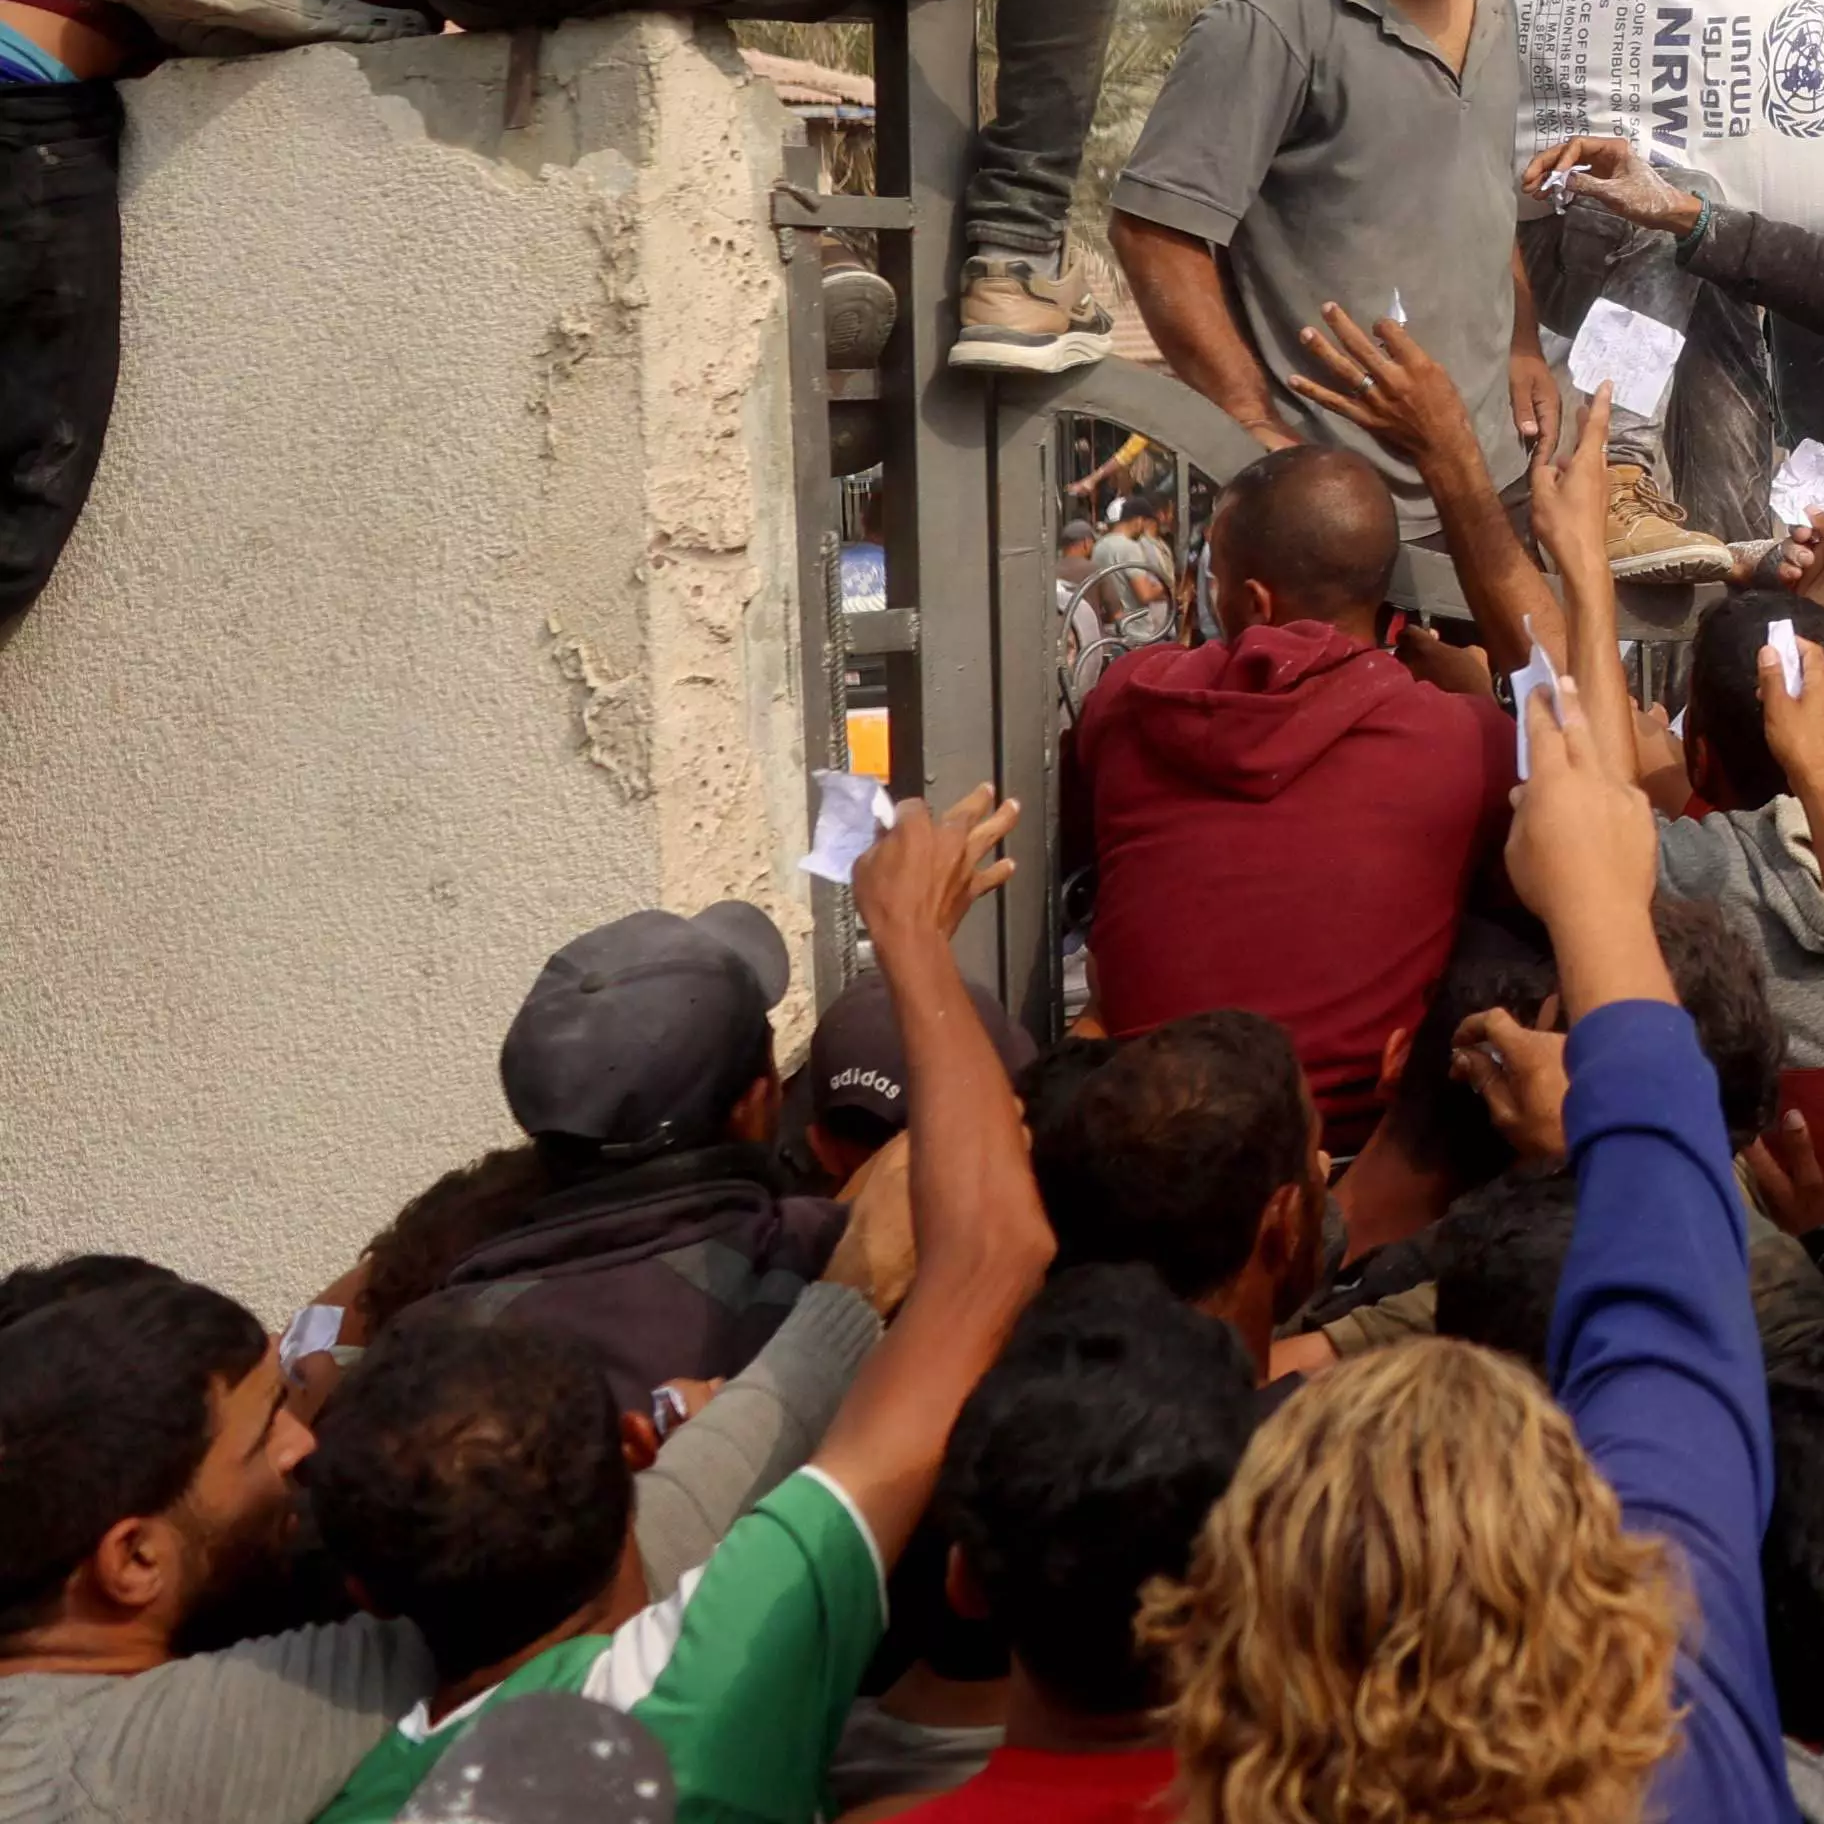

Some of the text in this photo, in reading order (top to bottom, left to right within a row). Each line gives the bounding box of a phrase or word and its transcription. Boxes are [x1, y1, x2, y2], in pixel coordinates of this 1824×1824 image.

[1533, 25, 1545, 51] SEP
[1545, 22, 1558, 53] MAR
[1560, 6, 1577, 60] MONTHS
[1576, 27, 1590, 49] OF
[1610, 6, 1628, 112] DISTRIBUTION
[1627, 40, 1643, 78] (NOT
[1532, 65, 1543, 90] OCT
[1543, 65, 1555, 92] APR
[1559, 65, 1572, 96] FROM
[1728, 15, 1752, 138] unrwa
[1628, 82, 1641, 113] FOR
[1535, 108, 1547, 135] NOV
[1547, 108, 1559, 134] MAY
[1611, 117, 1624, 136] TO
[1629, 117, 1640, 151] SAL
[829, 1067, 902, 1100] adidas
